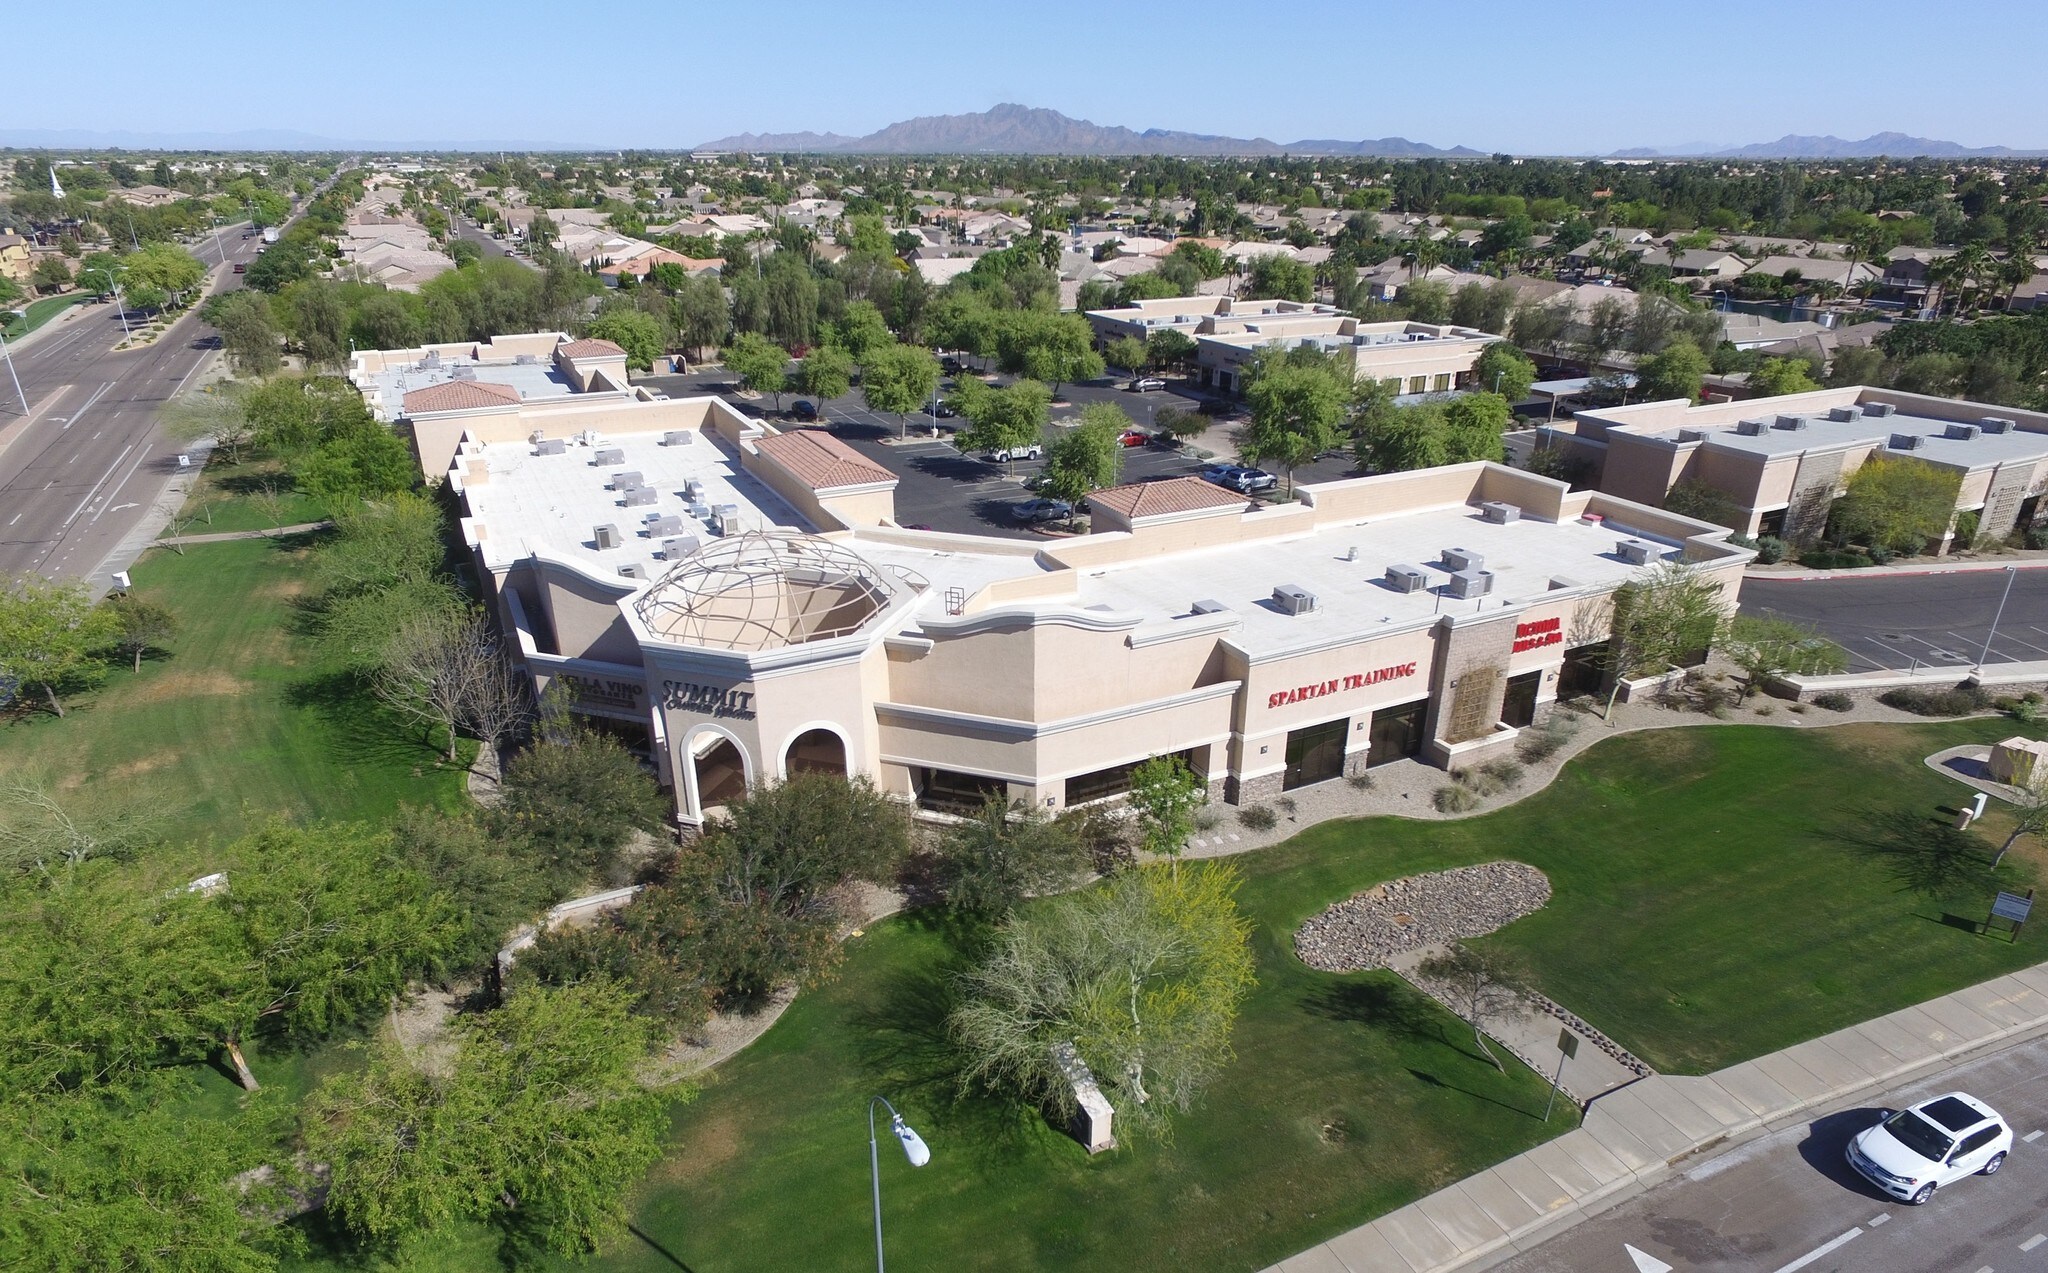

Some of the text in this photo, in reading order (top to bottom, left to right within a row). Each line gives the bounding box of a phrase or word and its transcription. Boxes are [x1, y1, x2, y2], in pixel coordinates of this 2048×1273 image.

[606, 680, 642, 695] VINO
[662, 680, 754, 709] SUMMIT
[1268, 662, 1417, 708] SPARTAN TRAINING
